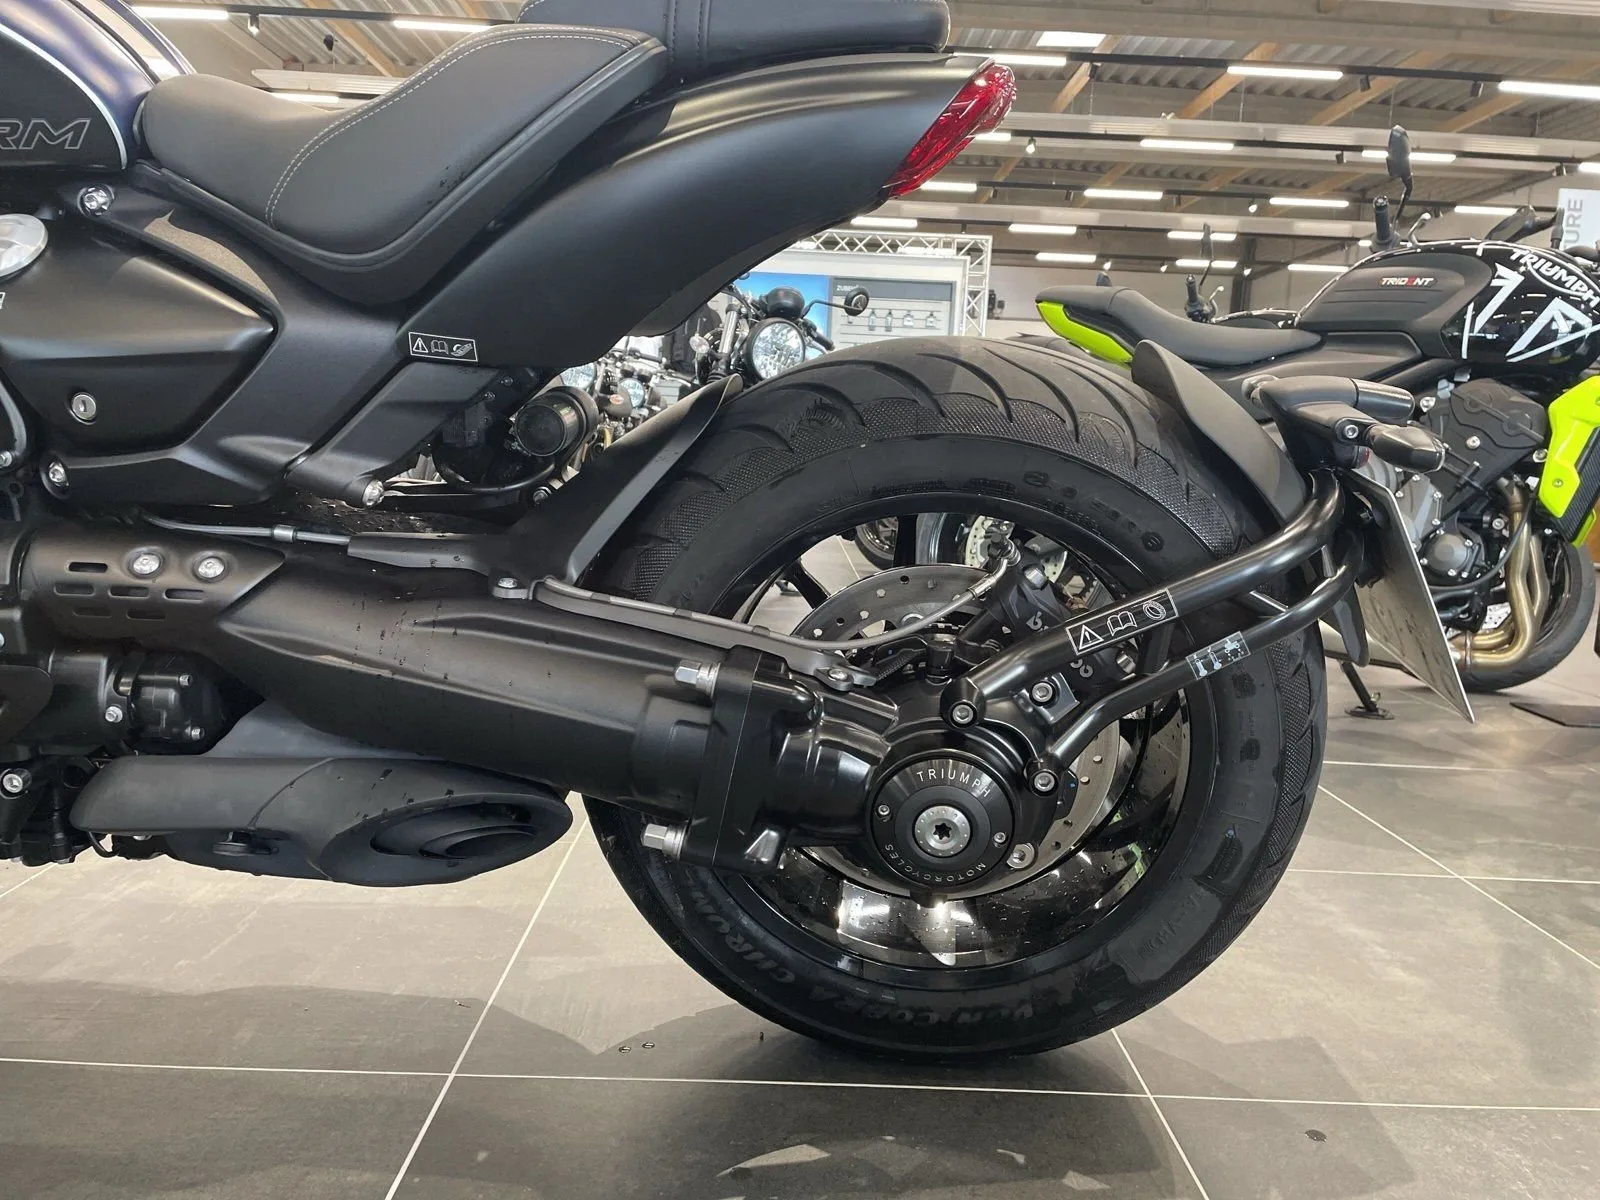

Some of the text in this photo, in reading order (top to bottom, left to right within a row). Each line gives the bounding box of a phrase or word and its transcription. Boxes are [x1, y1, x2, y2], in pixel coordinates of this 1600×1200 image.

[1381, 275, 1434, 287] TRIDENT
[1510, 248, 1600, 308] TRIUMPH
[917, 768, 991, 798] TRIUMPH
[884, 843, 987, 883] MOTORCYCLES
